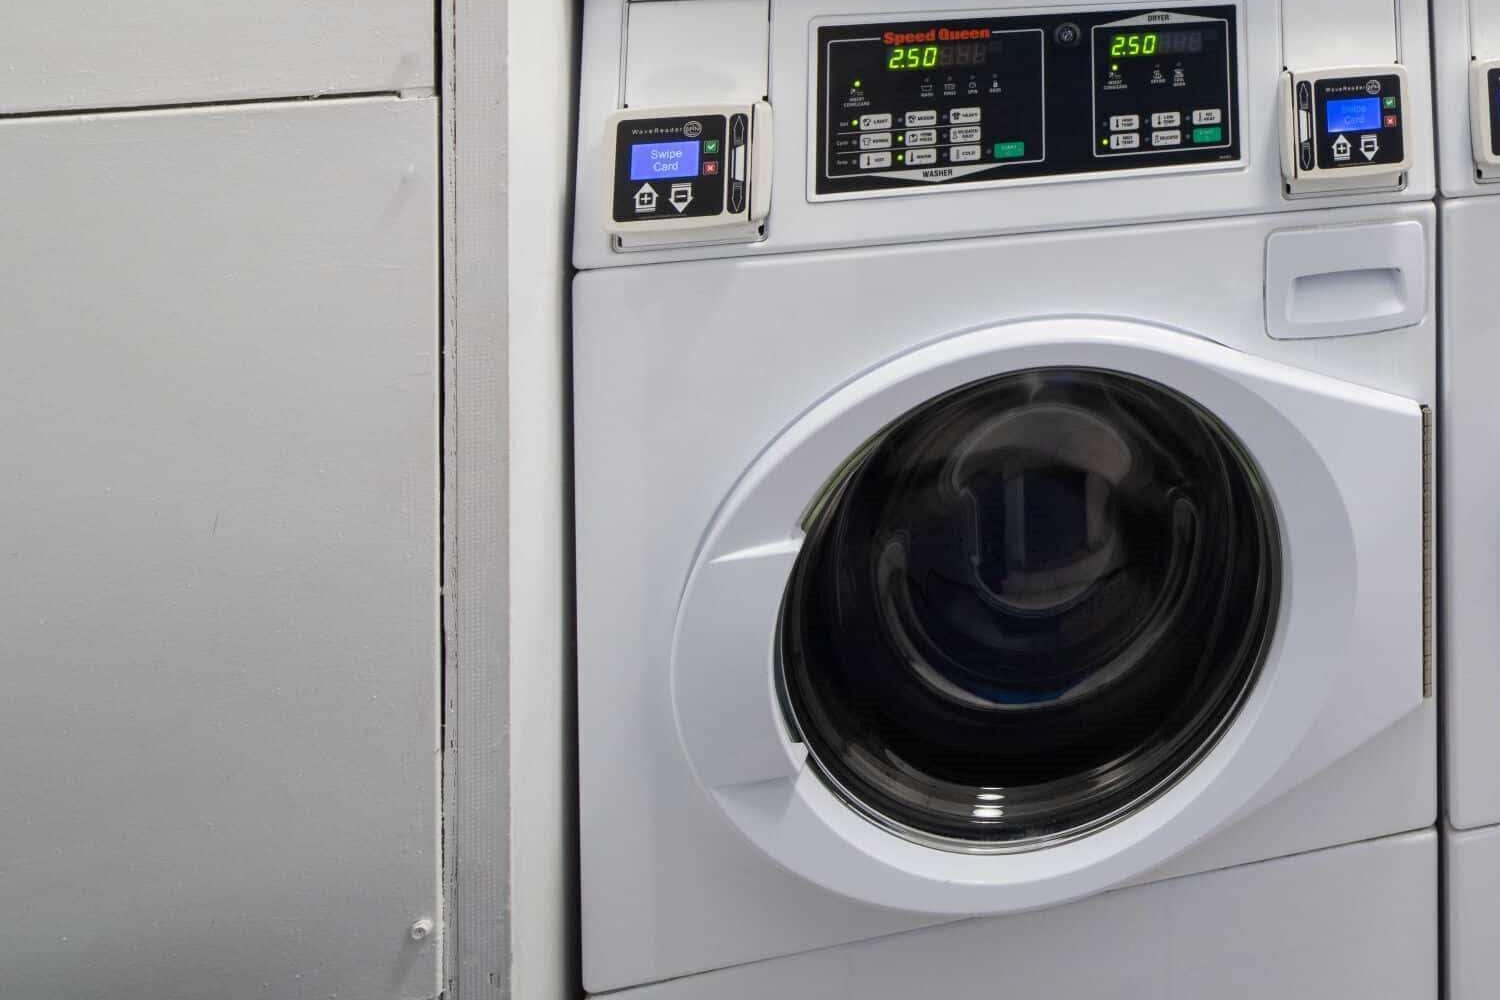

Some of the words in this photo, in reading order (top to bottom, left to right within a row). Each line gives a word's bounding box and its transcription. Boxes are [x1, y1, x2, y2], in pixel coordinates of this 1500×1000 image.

[1147, 14, 1170, 23] DRYER
[882, 28, 937, 46] Speed
[938, 28, 991, 41] Queen
[1111, 34, 1156, 56] 2.50
[888, 47, 938, 69] 2.50
[650, 149, 682, 161] Swipe
[653, 161, 679, 172] Card
[922, 168, 953, 178] WASHER
